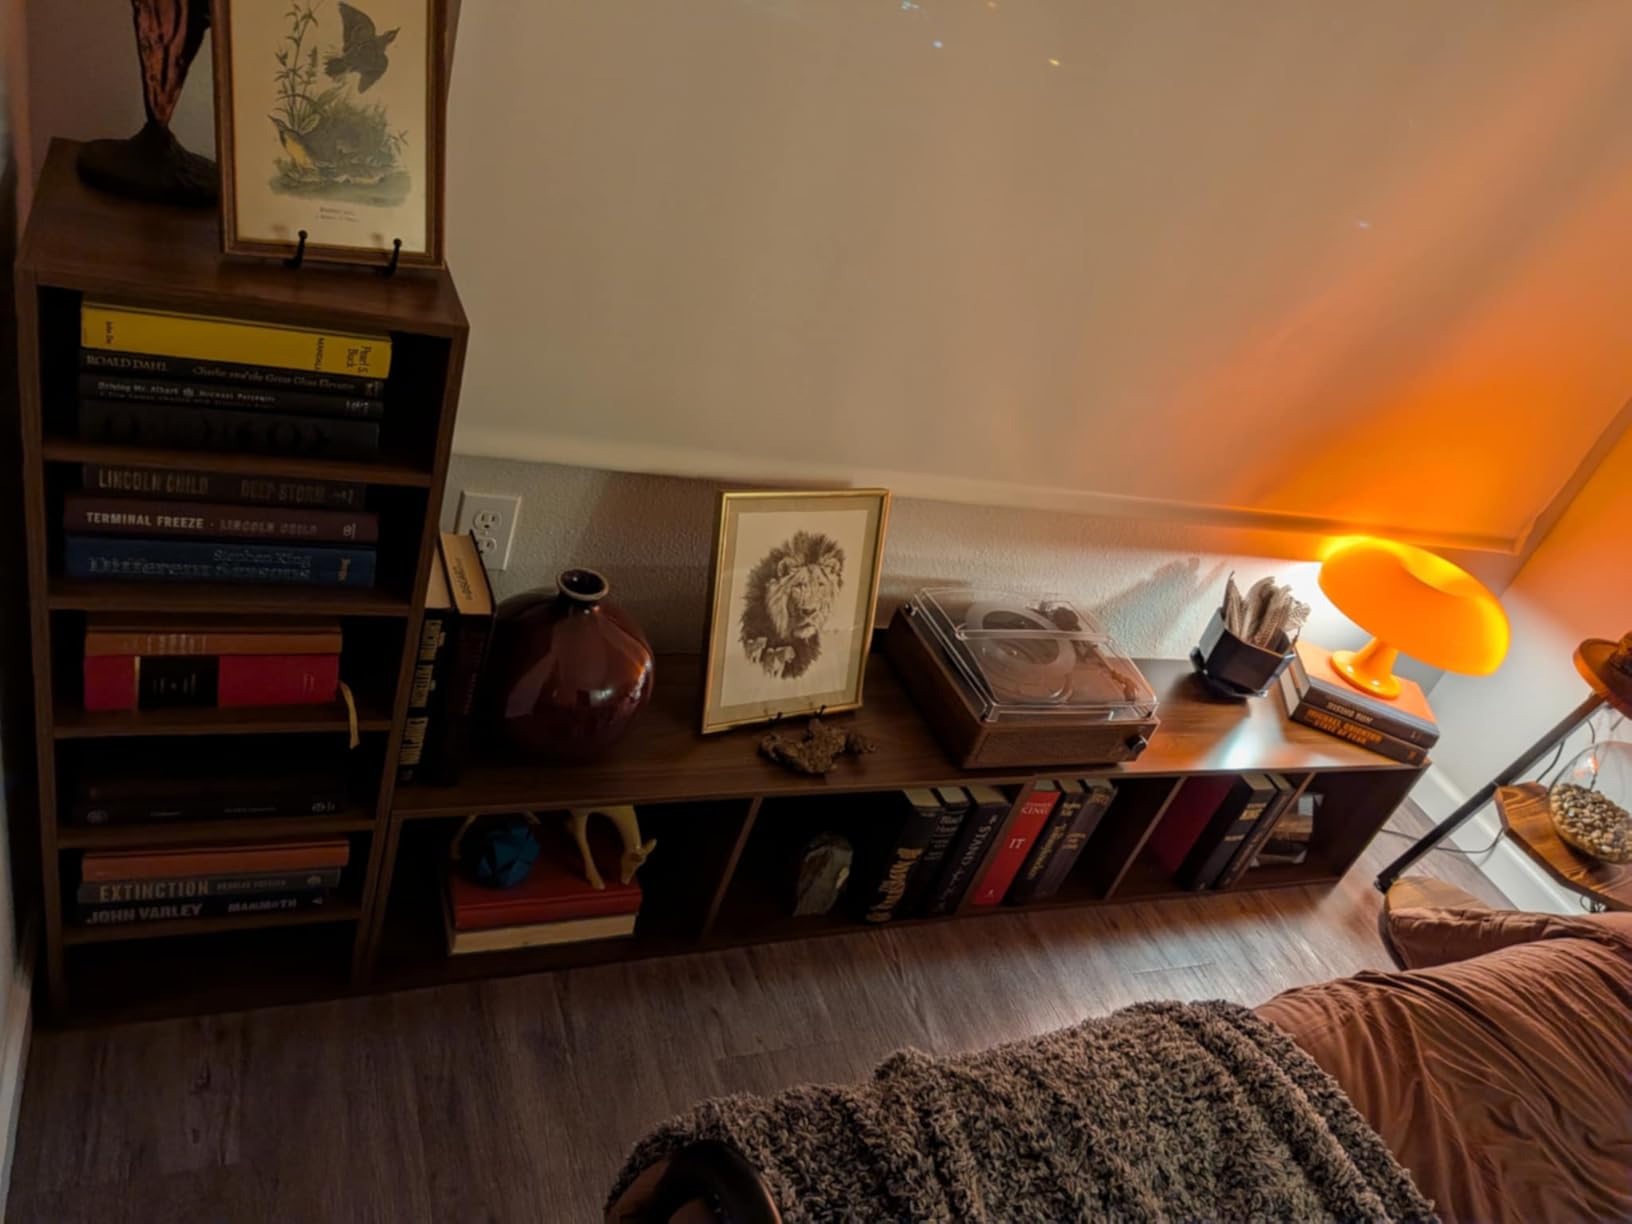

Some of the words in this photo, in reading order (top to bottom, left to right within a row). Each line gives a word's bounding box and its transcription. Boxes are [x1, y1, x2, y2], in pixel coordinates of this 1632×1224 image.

[85, 355, 130, 369] ROALD
[132, 359, 168, 372] DAHL
[98, 468, 162, 492] LINCOLN
[166, 472, 209, 496] CHILD
[279, 482, 327, 504] STORM
[86, 511, 153, 526] TERMINAL
[157, 515, 206, 529] FREEZE
[220, 519, 275, 534] LINCOLN
[88, 556, 208, 577] Different
[1021, 807, 1049, 815] KING
[961, 825, 993, 866] STAND
[1008, 837, 1027, 849] IT
[99, 879, 209, 903] EXTINCTION
[85, 908, 136, 925] JOHN
[137, 902, 203, 920] VARLEY
[228, 898, 297, 913] MAMMOTH
